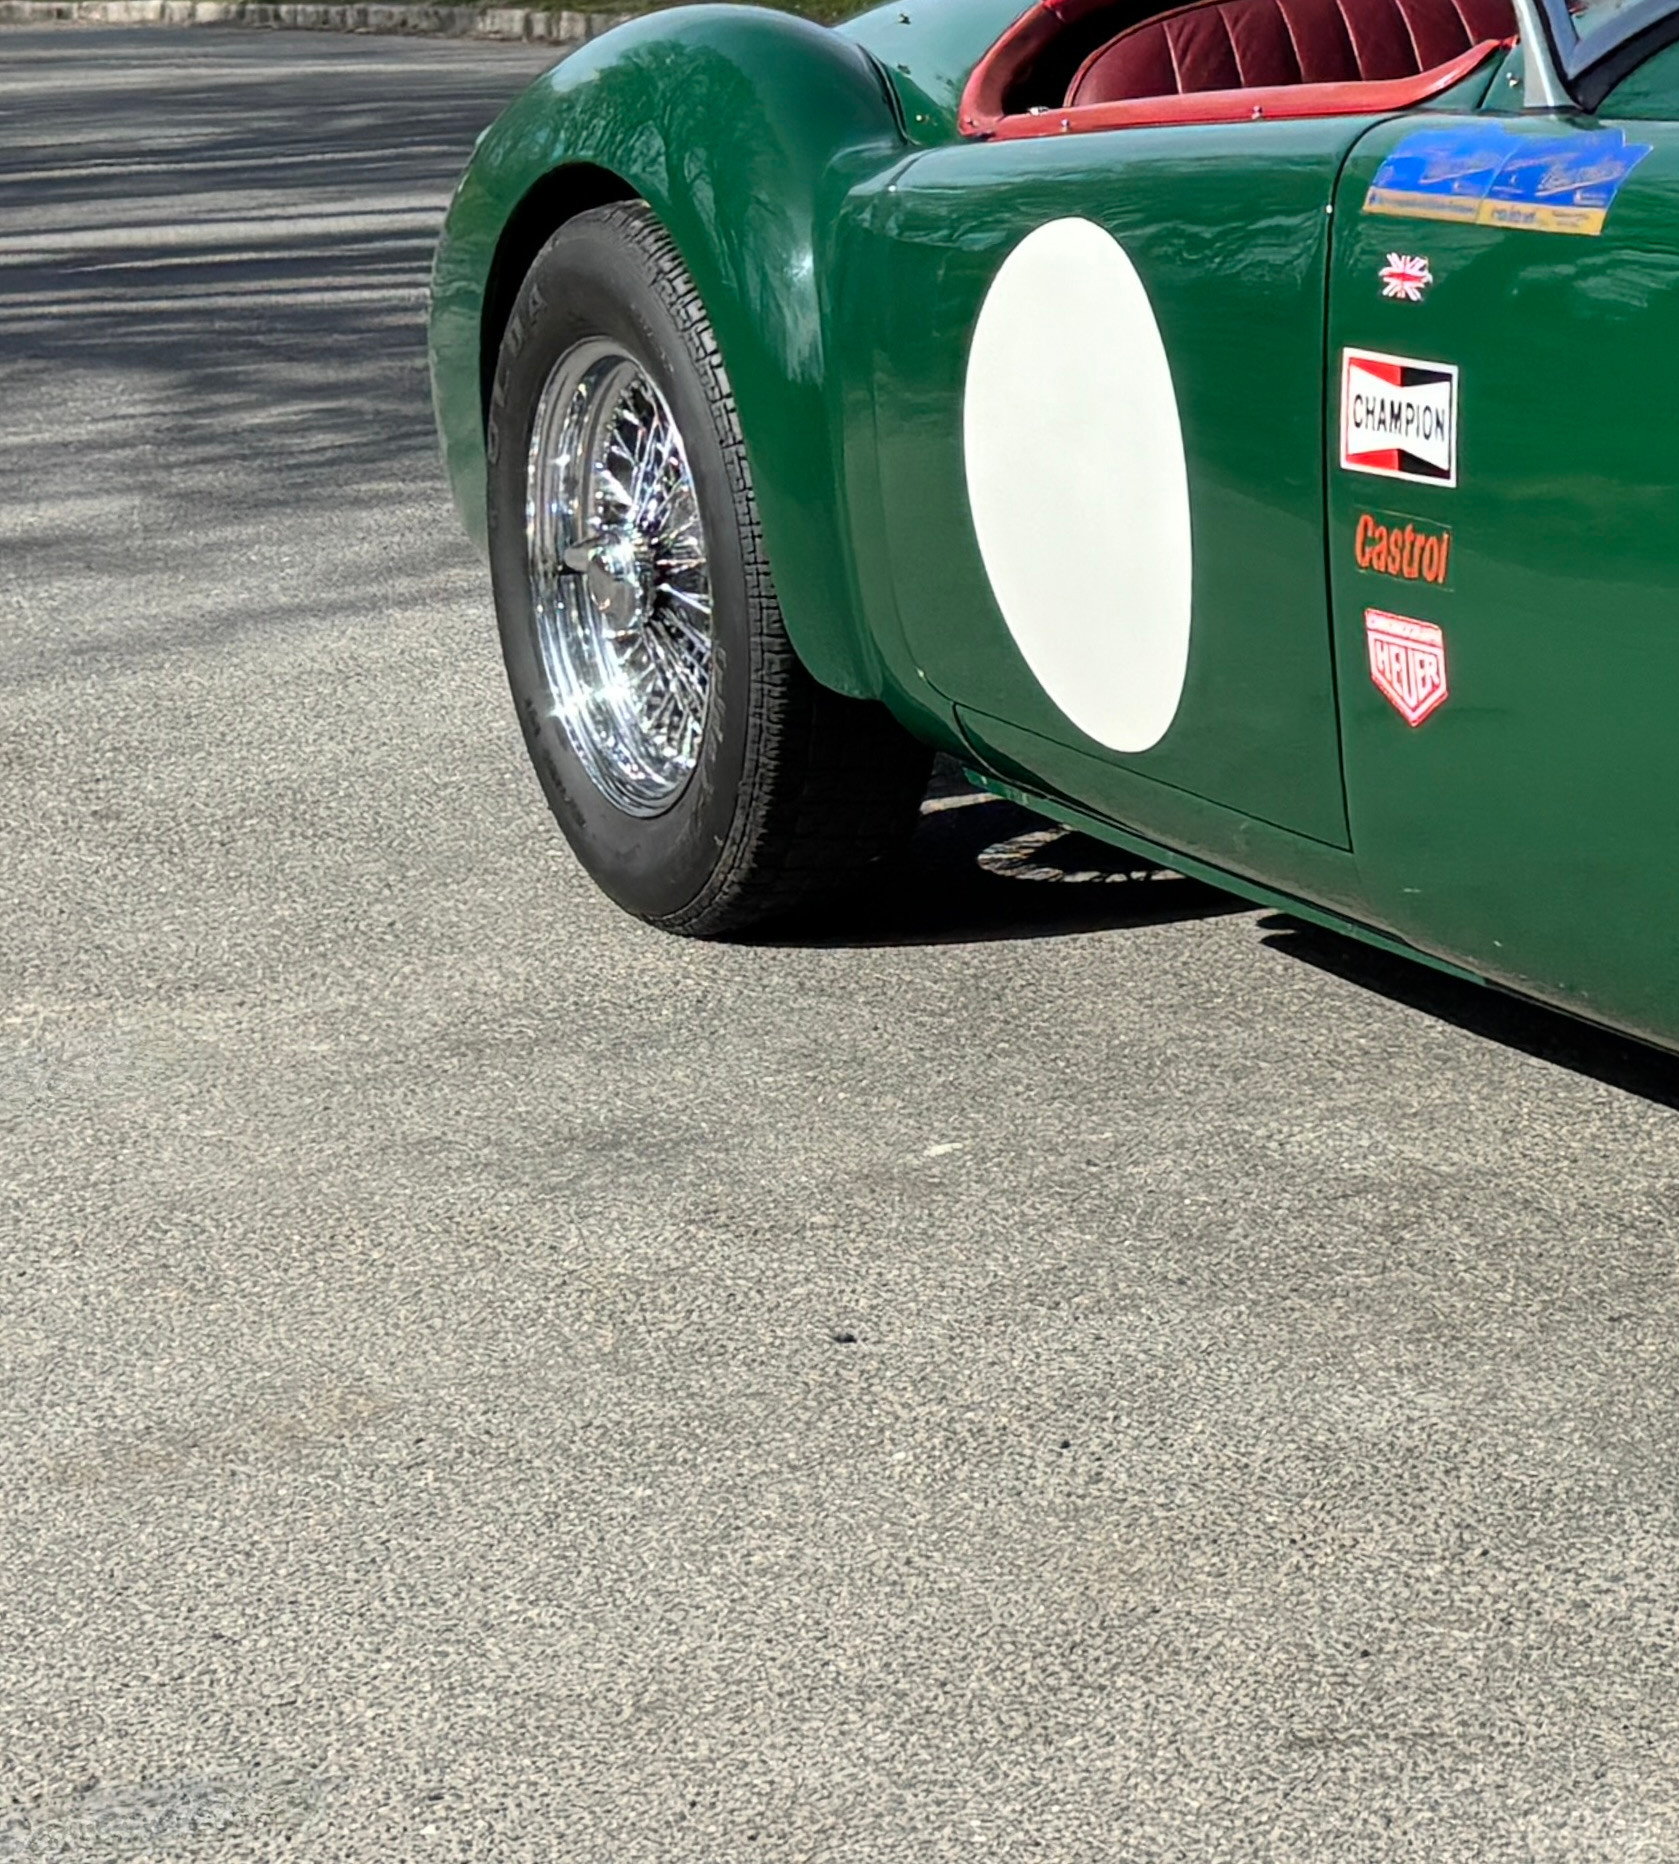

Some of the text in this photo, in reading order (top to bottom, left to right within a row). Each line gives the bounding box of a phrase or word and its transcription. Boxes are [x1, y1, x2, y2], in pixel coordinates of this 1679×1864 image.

[1353, 394, 1446, 442] CHAMPION
[1355, 514, 1448, 584] Castrol
[1374, 639, 1441, 710] HEUER
